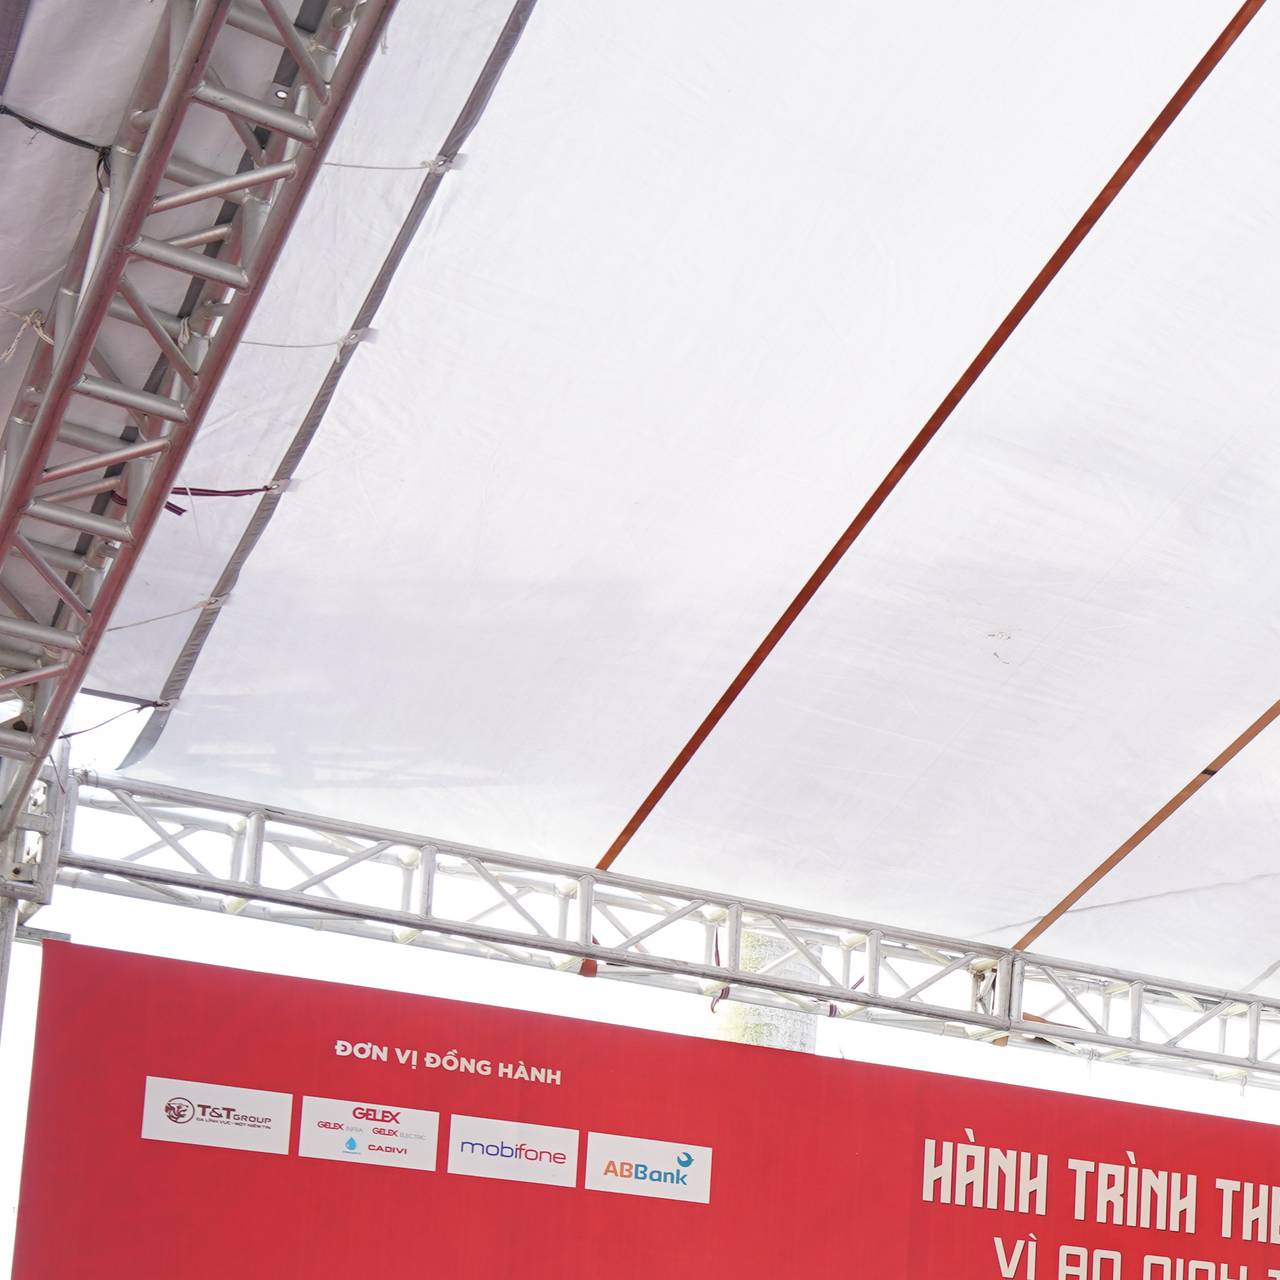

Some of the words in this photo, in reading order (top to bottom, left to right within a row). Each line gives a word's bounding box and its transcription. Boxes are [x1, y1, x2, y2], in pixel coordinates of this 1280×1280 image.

[335, 1040, 388, 1062] ĐƠN
[394, 1048, 418, 1069] VỊ
[424, 1049, 491, 1076] ĐỒNG
[498, 1061, 562, 1085] HÀNH
[197, 1103, 235, 1121] T&T
[233, 1113, 272, 1125] GROUP
[317, 1120, 345, 1131] GELEX
[352, 1106, 401, 1124] GELEX
[372, 1127, 399, 1137] GELEX
[368, 1144, 407, 1155] CADIVI
[460, 1139, 567, 1165] mobifone
[603, 1160, 689, 1186] ABBank
[922, 1128, 1048, 1216] HÀNH
[1068, 1151, 1198, 1234] TRÌNH
[994, 1232, 1038, 1280] VÌ
